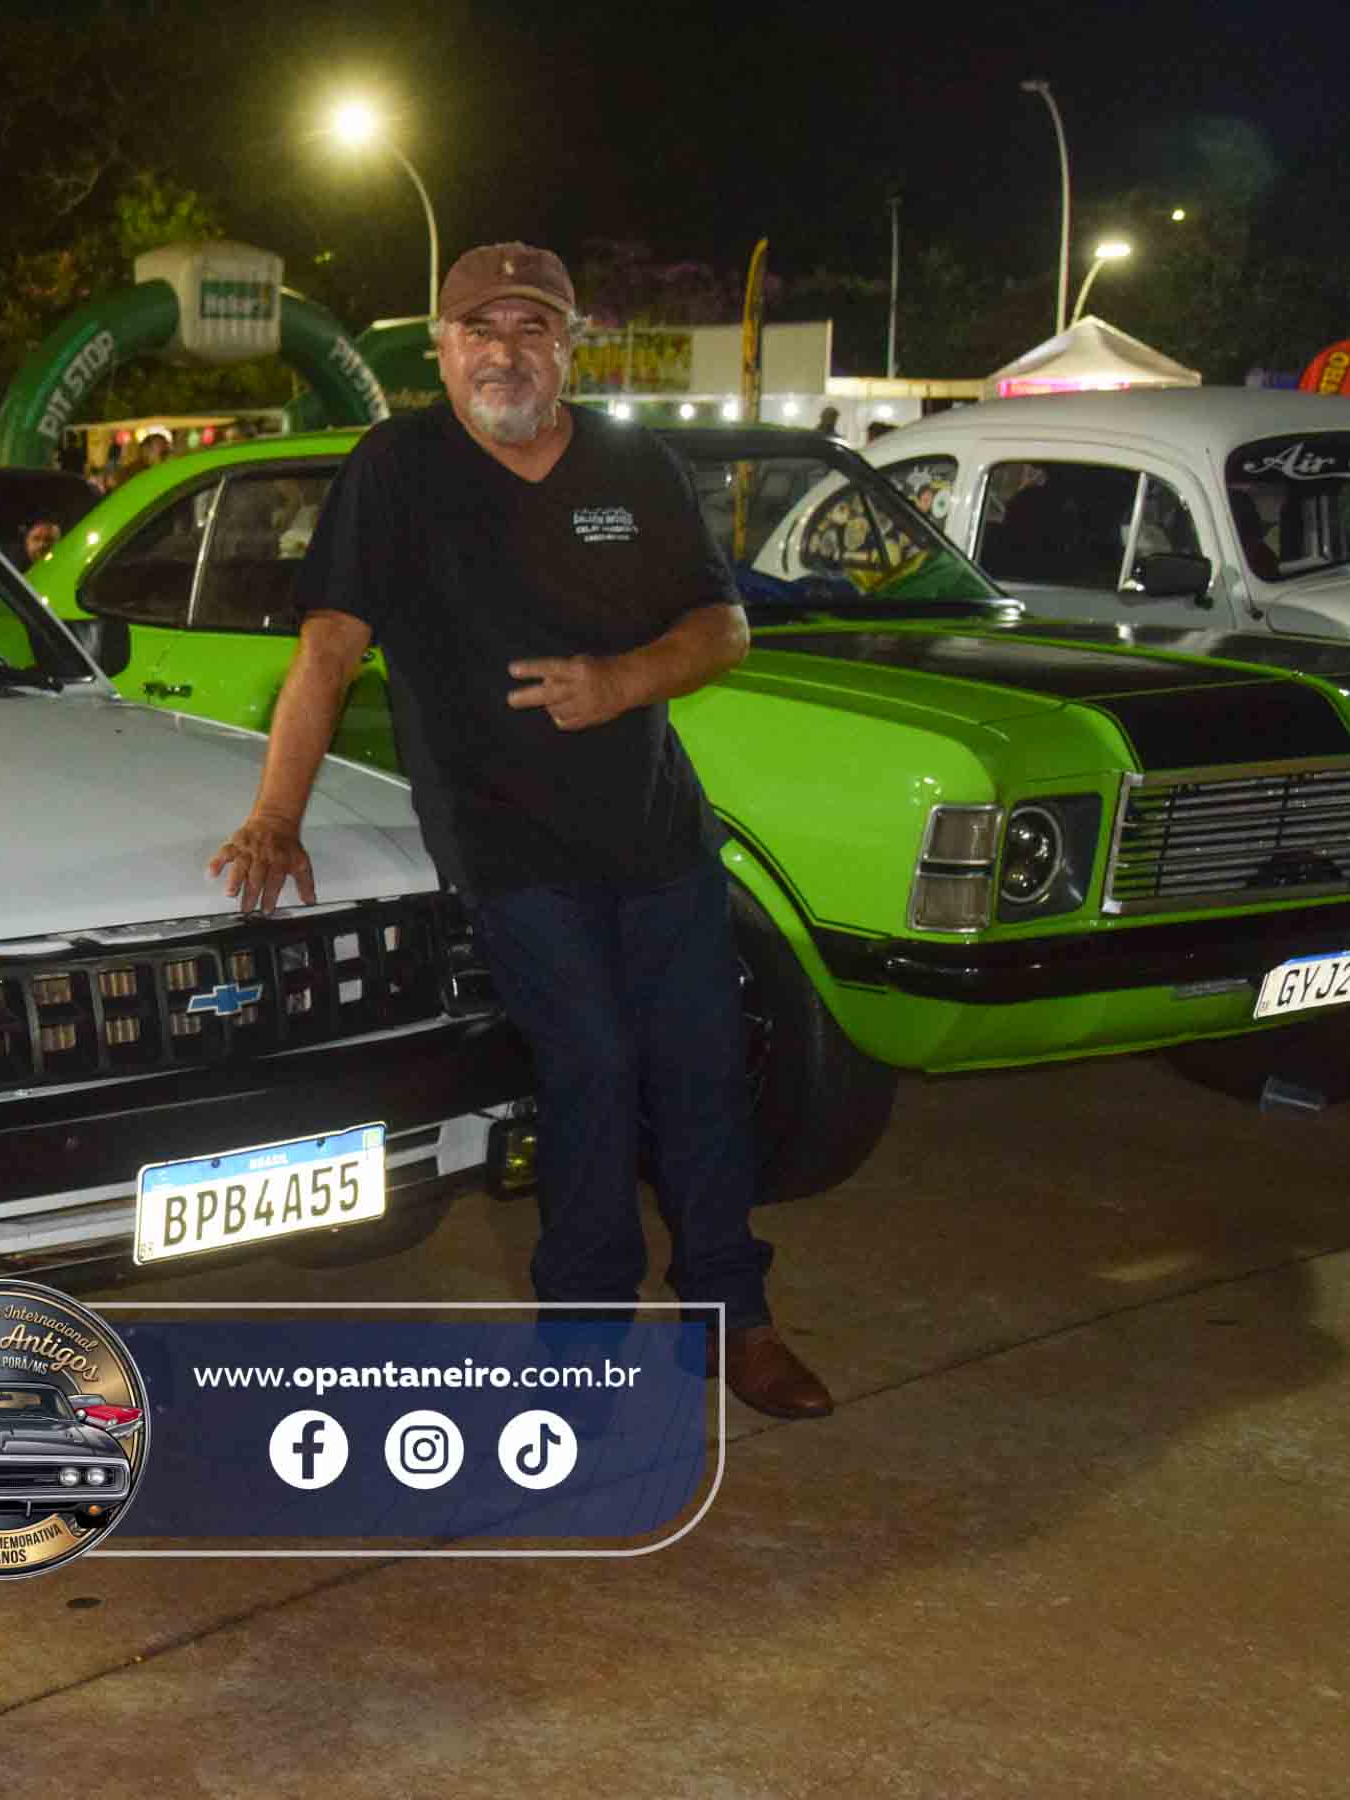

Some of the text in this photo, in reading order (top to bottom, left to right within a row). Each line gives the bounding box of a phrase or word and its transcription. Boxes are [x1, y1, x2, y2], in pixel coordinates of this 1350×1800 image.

[35, 330, 115, 438] PIT STOP
[1276, 961, 1350, 1007] GYJ2
[163, 1160, 360, 1248] BPB4A55
